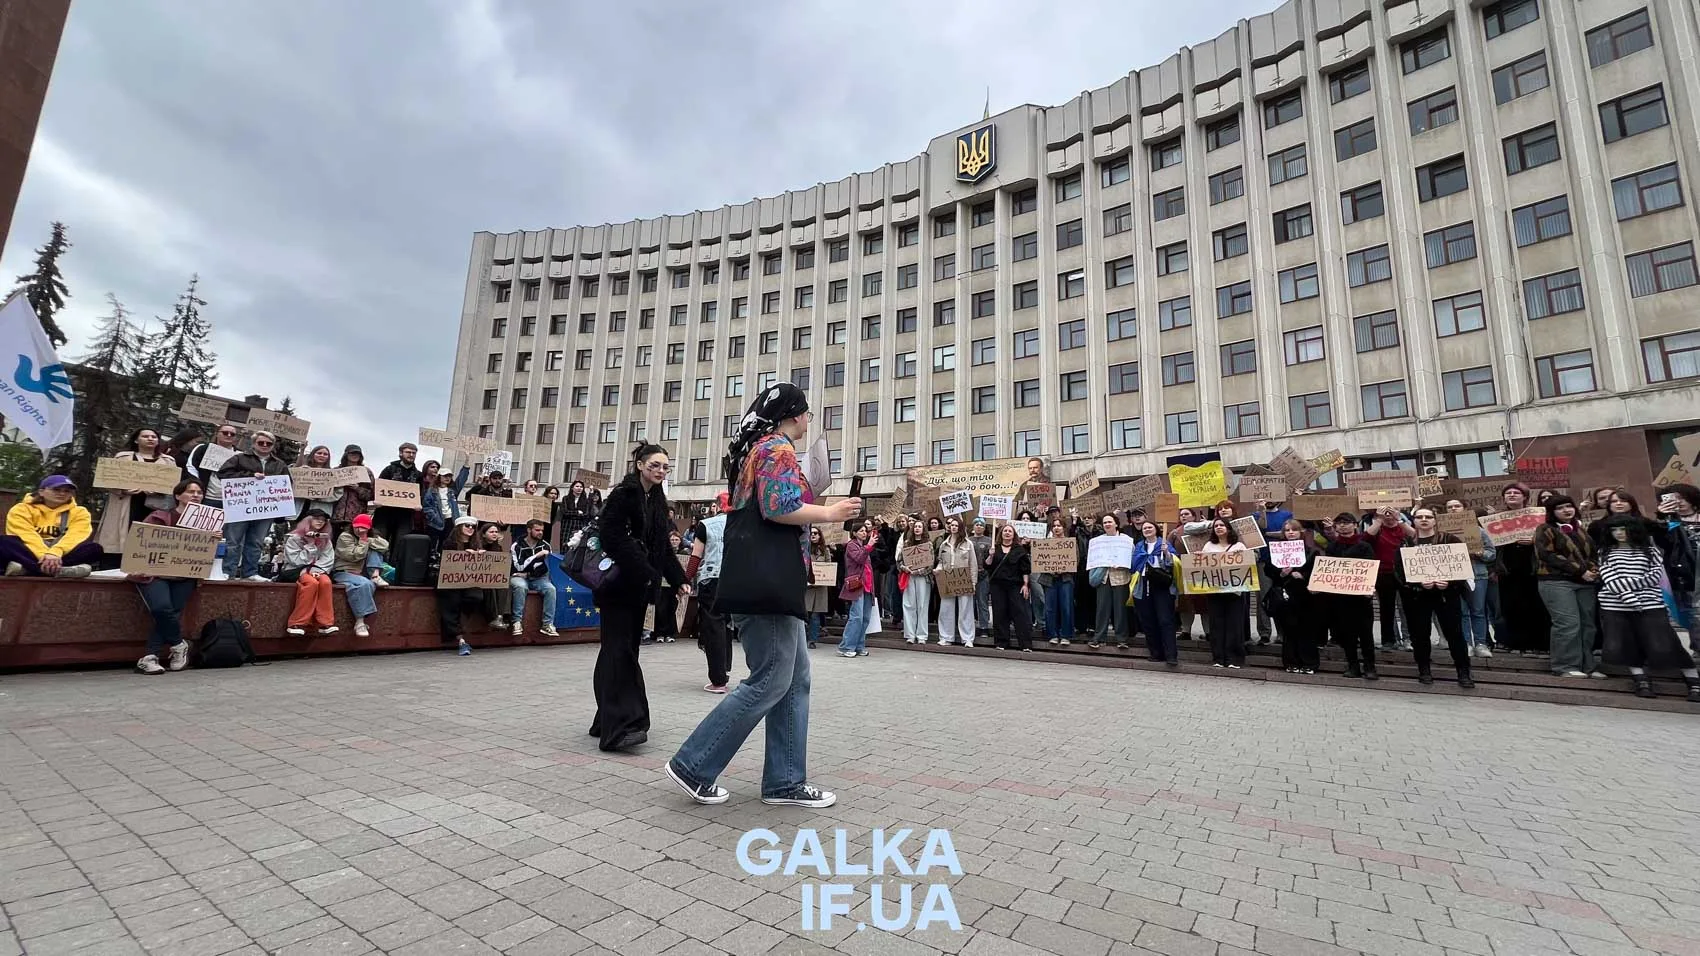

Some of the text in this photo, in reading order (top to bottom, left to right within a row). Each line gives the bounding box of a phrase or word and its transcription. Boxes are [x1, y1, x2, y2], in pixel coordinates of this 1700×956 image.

[0, 380, 47, 426] an Rights
[924, 477, 948, 486] «Дух,
[969, 474, 994, 482] тіло
[965, 483, 977, 491] до
[1076, 479, 1093, 493] 15150
[380, 489, 417, 499] 15150
[179, 503, 225, 531] ГАНЬБА
[136, 528, 216, 544] Я ПРОЧИТАЛА
[1057, 541, 1075, 549] 15150
[1415, 545, 1452, 556] ДАВАЙ
[147, 551, 168, 564] НЕ
[446, 553, 452, 562] Я
[452, 553, 476, 562] САМА
[1191, 551, 1244, 567] #15150
[1318, 559, 1336, 567] МИ
[464, 563, 492, 571] КОЛИ
[442, 573, 508, 583] РОЗЛУЧАТИСЬ
[945, 568, 969, 579] МИ
[1191, 567, 1254, 588] ГАНЬБА
